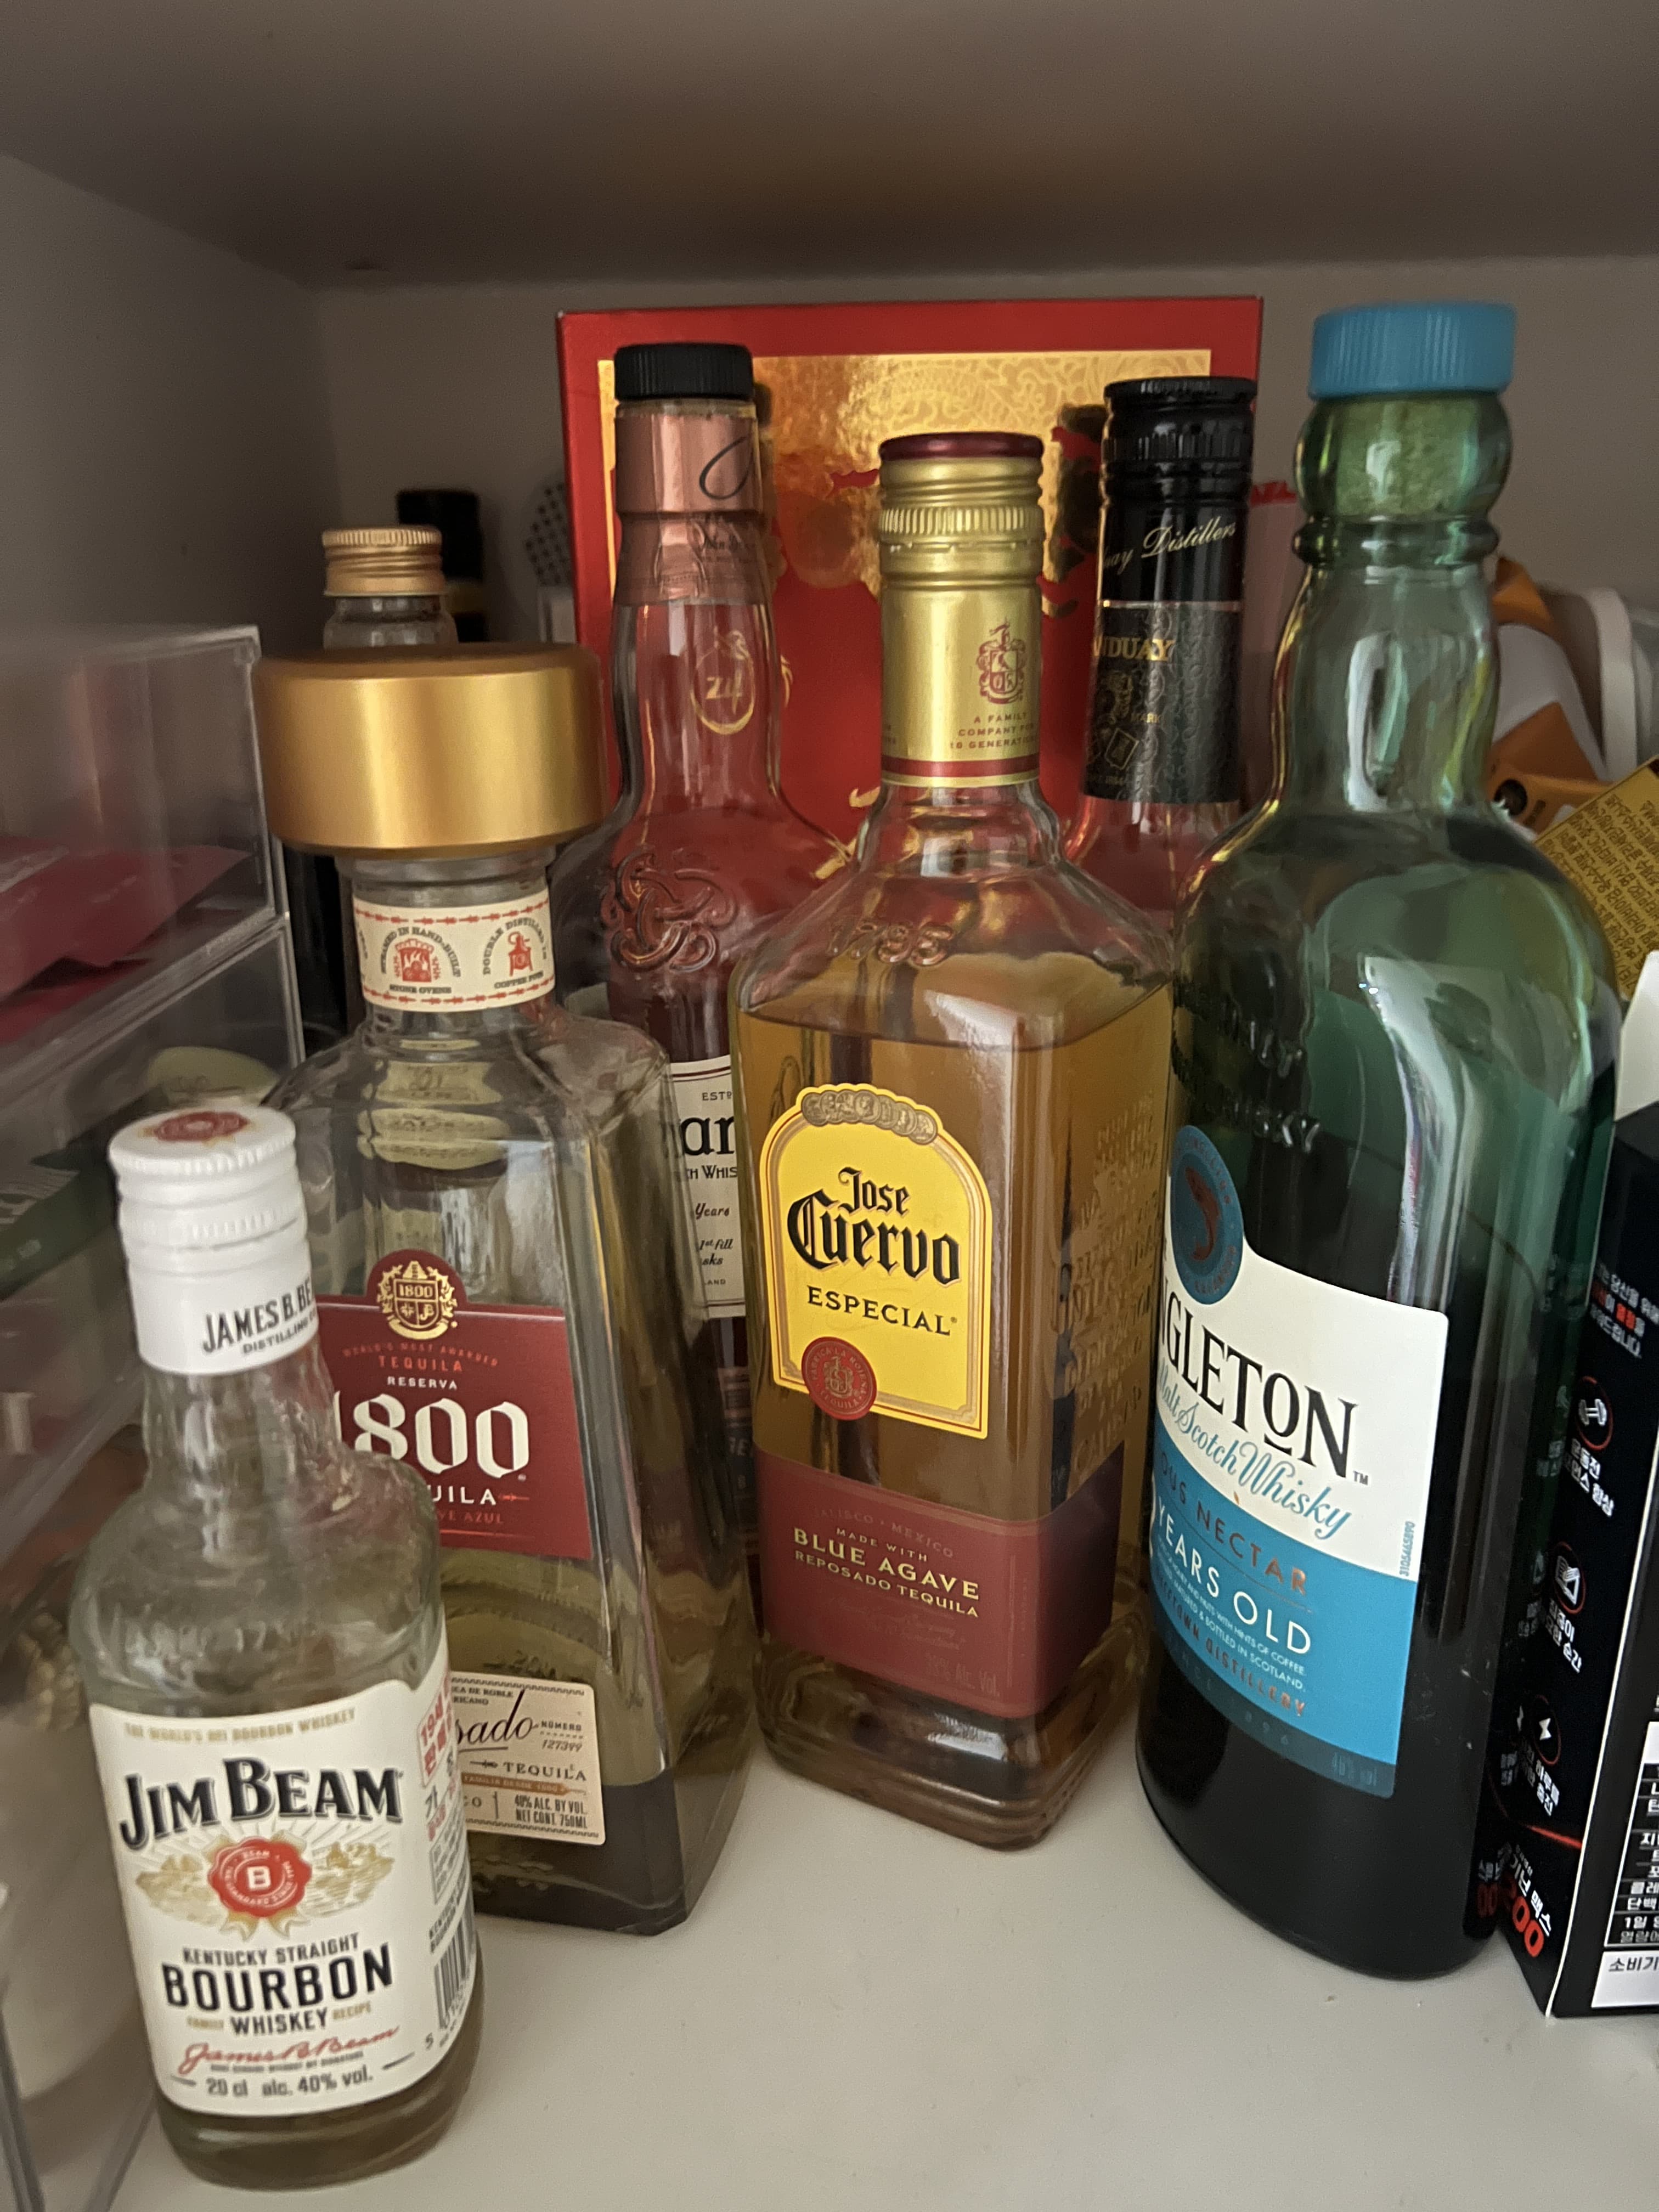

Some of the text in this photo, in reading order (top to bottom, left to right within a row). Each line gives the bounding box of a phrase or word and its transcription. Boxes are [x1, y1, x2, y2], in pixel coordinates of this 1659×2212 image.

[1141, 515, 1236, 558] Distillers
[838, 1166, 910, 1216] Jose
[695, 1203, 730, 1220] Years
[787, 1188, 961, 1286] Cuervo
[398, 1282, 434, 1298] 1800
[202, 1301, 278, 1354] JAMES
[806, 1285, 951, 1336] ESPECIAL
[378, 1355, 462, 1372] TEQUILA
[387, 1375, 458, 1390] RESERVA
[1239, 1441, 1352, 1539] Whisky
[836, 1527, 927, 1562] MADE WITH
[891, 1522, 953, 1558] MEXICO
[1197, 1500, 1307, 1595] NECTAR
[793, 1527, 979, 1600] BLUE AGAVE
[1158, 1496, 1220, 1599] YEARS
[1233, 1591, 1311, 1655] OLD
[795, 1550, 979, 1618] REPOSADO TEQUILA
[1205, 1615, 1237, 1649] BOTTLED
[1250, 1652, 1307, 1693] SCOTLAND.
[1205, 1637, 1306, 1717] DISTILLERY
[453, 1696, 489, 1706] RICANO
[503, 1762, 587, 1782] TEQUILA
[119, 1771, 221, 1850] JIM
[222, 1756, 404, 1824] BEAM
[555, 1799, 567, 1812] BY
[247, 1866, 272, 1892] B
[182, 1932, 359, 1966] KENTUCKY STRAIGHT
[1609, 1957, 1658, 1972] 소비기
[161, 1942, 393, 2012] BOURBON
[229, 2007, 328, 2035] WHISKEY
[206, 2076, 227, 2095] 20
[233, 2079, 247, 2096] cl
[297, 2073, 336, 2093] 40%
[342, 2064, 374, 2086] vol.
